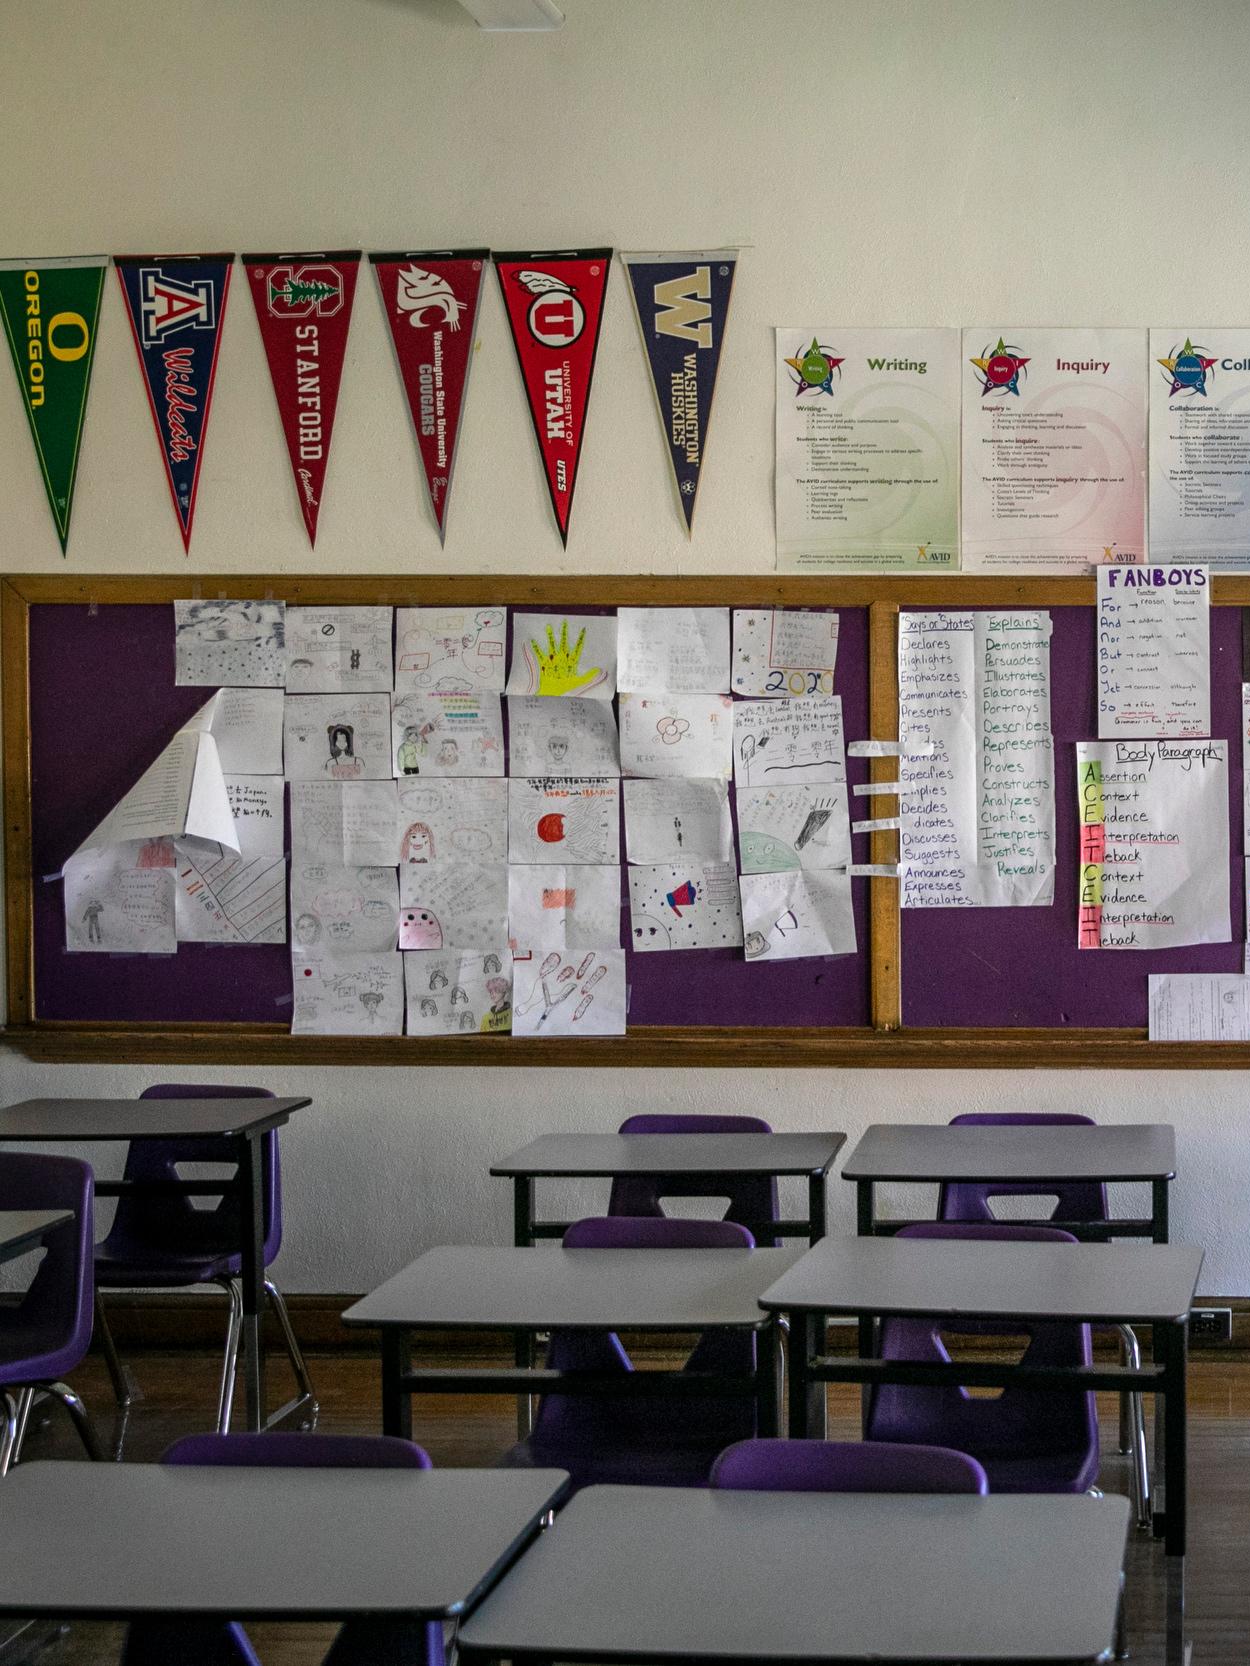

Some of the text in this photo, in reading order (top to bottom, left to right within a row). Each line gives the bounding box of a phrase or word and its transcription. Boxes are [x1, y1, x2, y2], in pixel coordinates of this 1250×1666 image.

[655, 266, 713, 348] W
[48, 311, 89, 362] O
[432, 331, 445, 388] Washington
[867, 359, 928, 374] Writing
[1056, 359, 1110, 375] Inquiry
[295, 325, 323, 461] STANFORD
[418, 364, 436, 437] COUGARS
[162, 347, 199, 464] Wildcats
[436, 390, 446, 417] State
[545, 368, 567, 441] UTAH
[562, 361, 575, 447] UNIVERSITY OF
[670, 372, 686, 446] HUSKIES
[682, 353, 699, 464] WASHINGTON
[796, 405, 822, 413] Writing
[982, 406, 1006, 414] Inquiry
[437, 418, 447, 469] University
[556, 460, 567, 492] UTES
[929, 552, 950, 561] AVID
[1114, 553, 1136, 562] AVID
[1108, 569, 1207, 588] FANBOYS
[1101, 598, 1122, 613] For
[1100, 617, 1121, 629] And
[902, 637, 950, 650] Declares
[984, 653, 1042, 668] Persuades
[1100, 648, 1122, 661] But
[984, 670, 1047, 683] Illustrates
[1100, 665, 1115, 674] Or
[765, 670, 834, 695] 2020
[901, 671, 961, 689] Emphasizes
[1100, 681, 1121, 694] Yet
[901, 689, 968, 701] Communicates
[983, 686, 1048, 699] Elaborates
[902, 704, 952, 719] Presents
[983, 700, 1039, 719] Portrays
[1100, 700, 1116, 713] So
[901, 721, 931, 733] Cites
[983, 717, 1050, 734] Describes
[984, 736, 1051, 756] Represents
[1115, 740, 1218, 772] Body Paragraph
[984, 756, 1025, 774] Proves
[1084, 763, 1146, 783] Assertion
[982, 778, 1050, 791] Constructs
[1084, 784, 1140, 802] Context
[902, 801, 948, 815] Decides
[982, 793, 1041, 811] Analyzes
[981, 811, 1036, 824] Clarifies
[1084, 803, 1149, 824] Evidence
[902, 833, 958, 846] Discusses
[980, 826, 1050, 841] Interprets
[1085, 824, 1180, 847] Interpretation
[904, 848, 961, 865] Suggests
[905, 867, 966, 879] Announces
[997, 859, 1046, 877] Reveals
[1083, 864, 1145, 883] Context
[905, 881, 962, 894] Expresses
[1082, 884, 1147, 904] Evidence
[904, 893, 974, 907] Articulates
[1082, 906, 1175, 928] Interpretation
